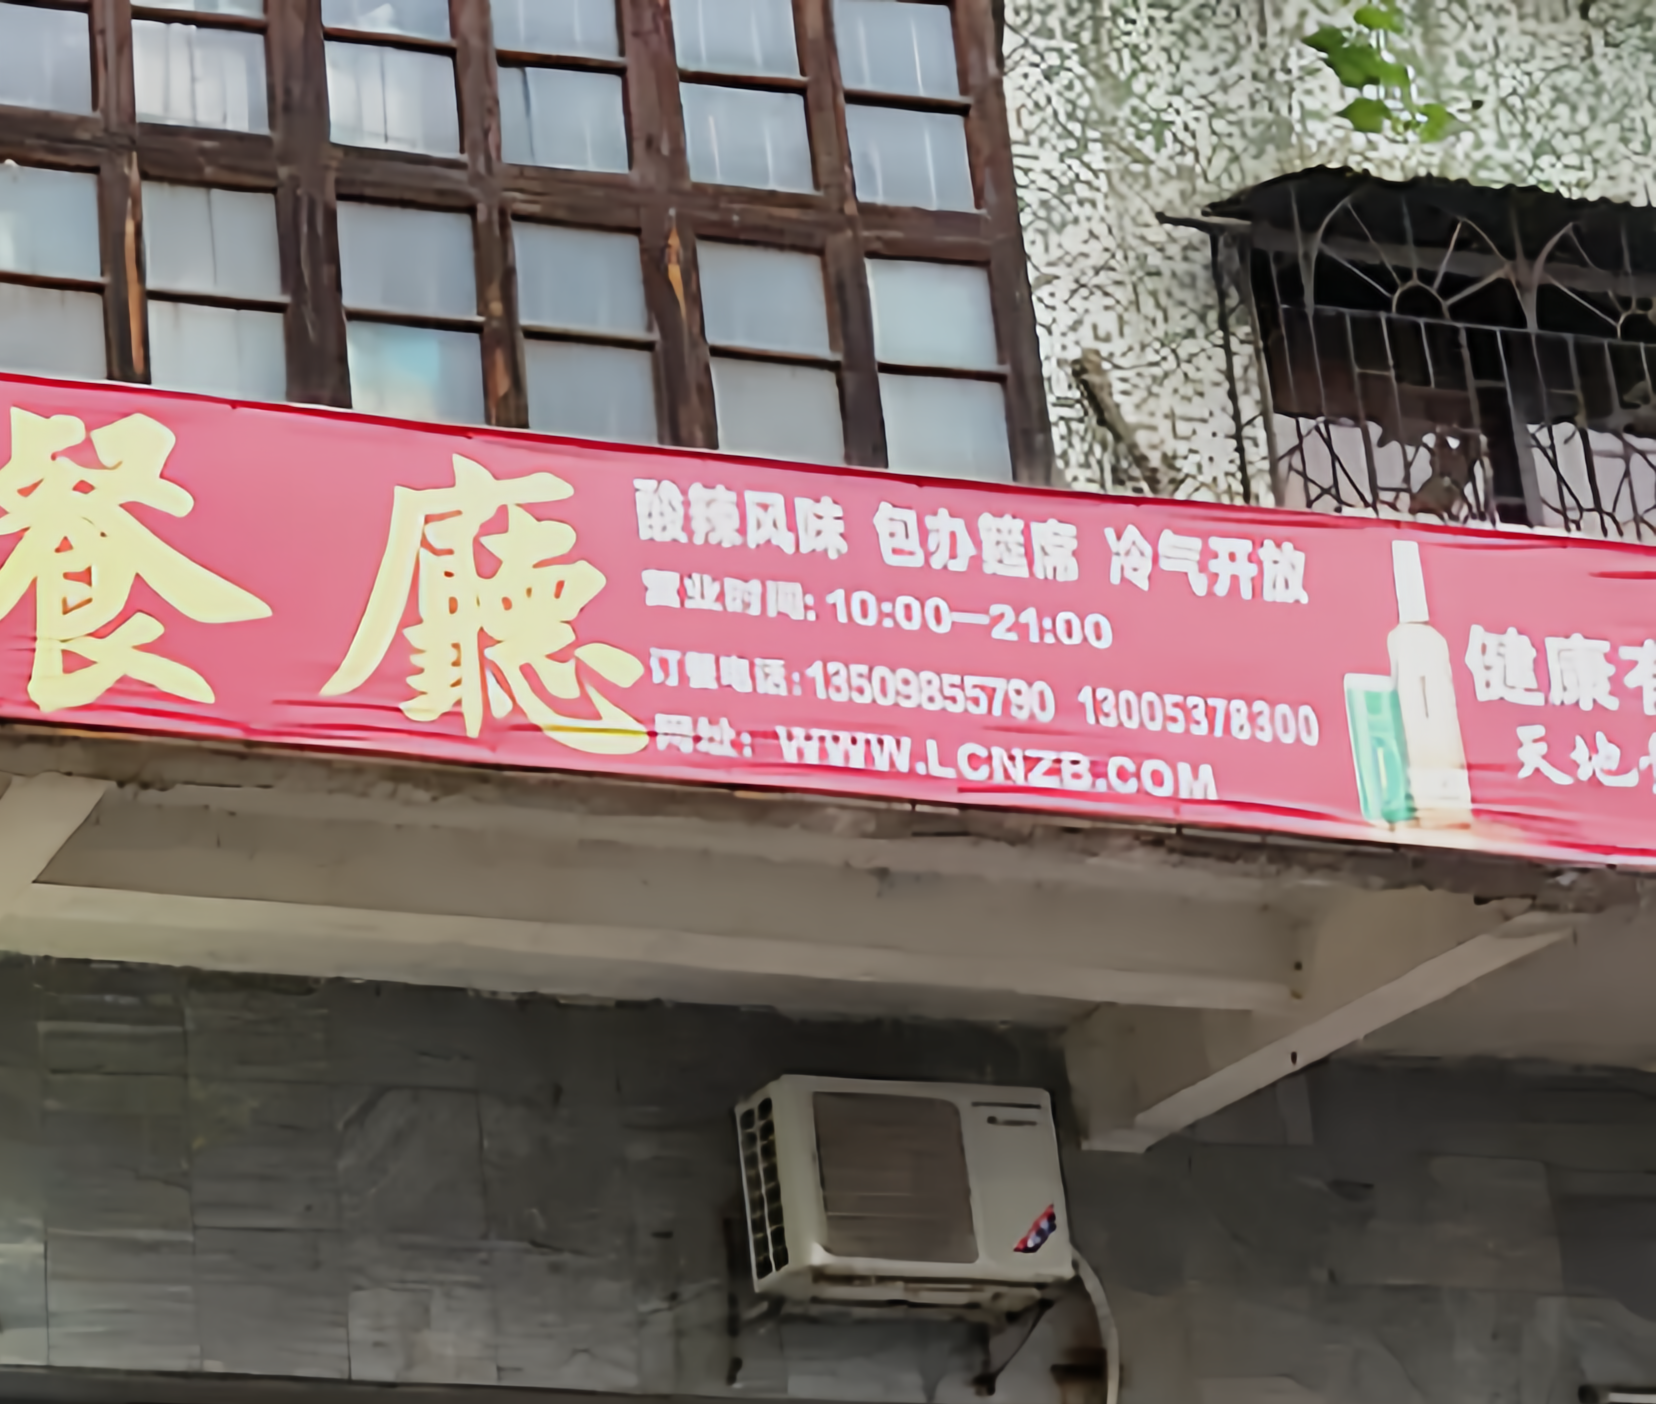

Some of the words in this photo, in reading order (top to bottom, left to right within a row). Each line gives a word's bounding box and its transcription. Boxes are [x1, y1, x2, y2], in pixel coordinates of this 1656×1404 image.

[632, 478, 848, 559] 酸辣风味
[872, 500, 1079, 582] 包办筵席
[1103, 523, 1309, 604] 冷气开放
[1077, 685, 1319, 747] 13005378300
[775, 725, 1219, 801] WWW.LCNZB.COM
[1515, 723, 1656, 794] 天地
